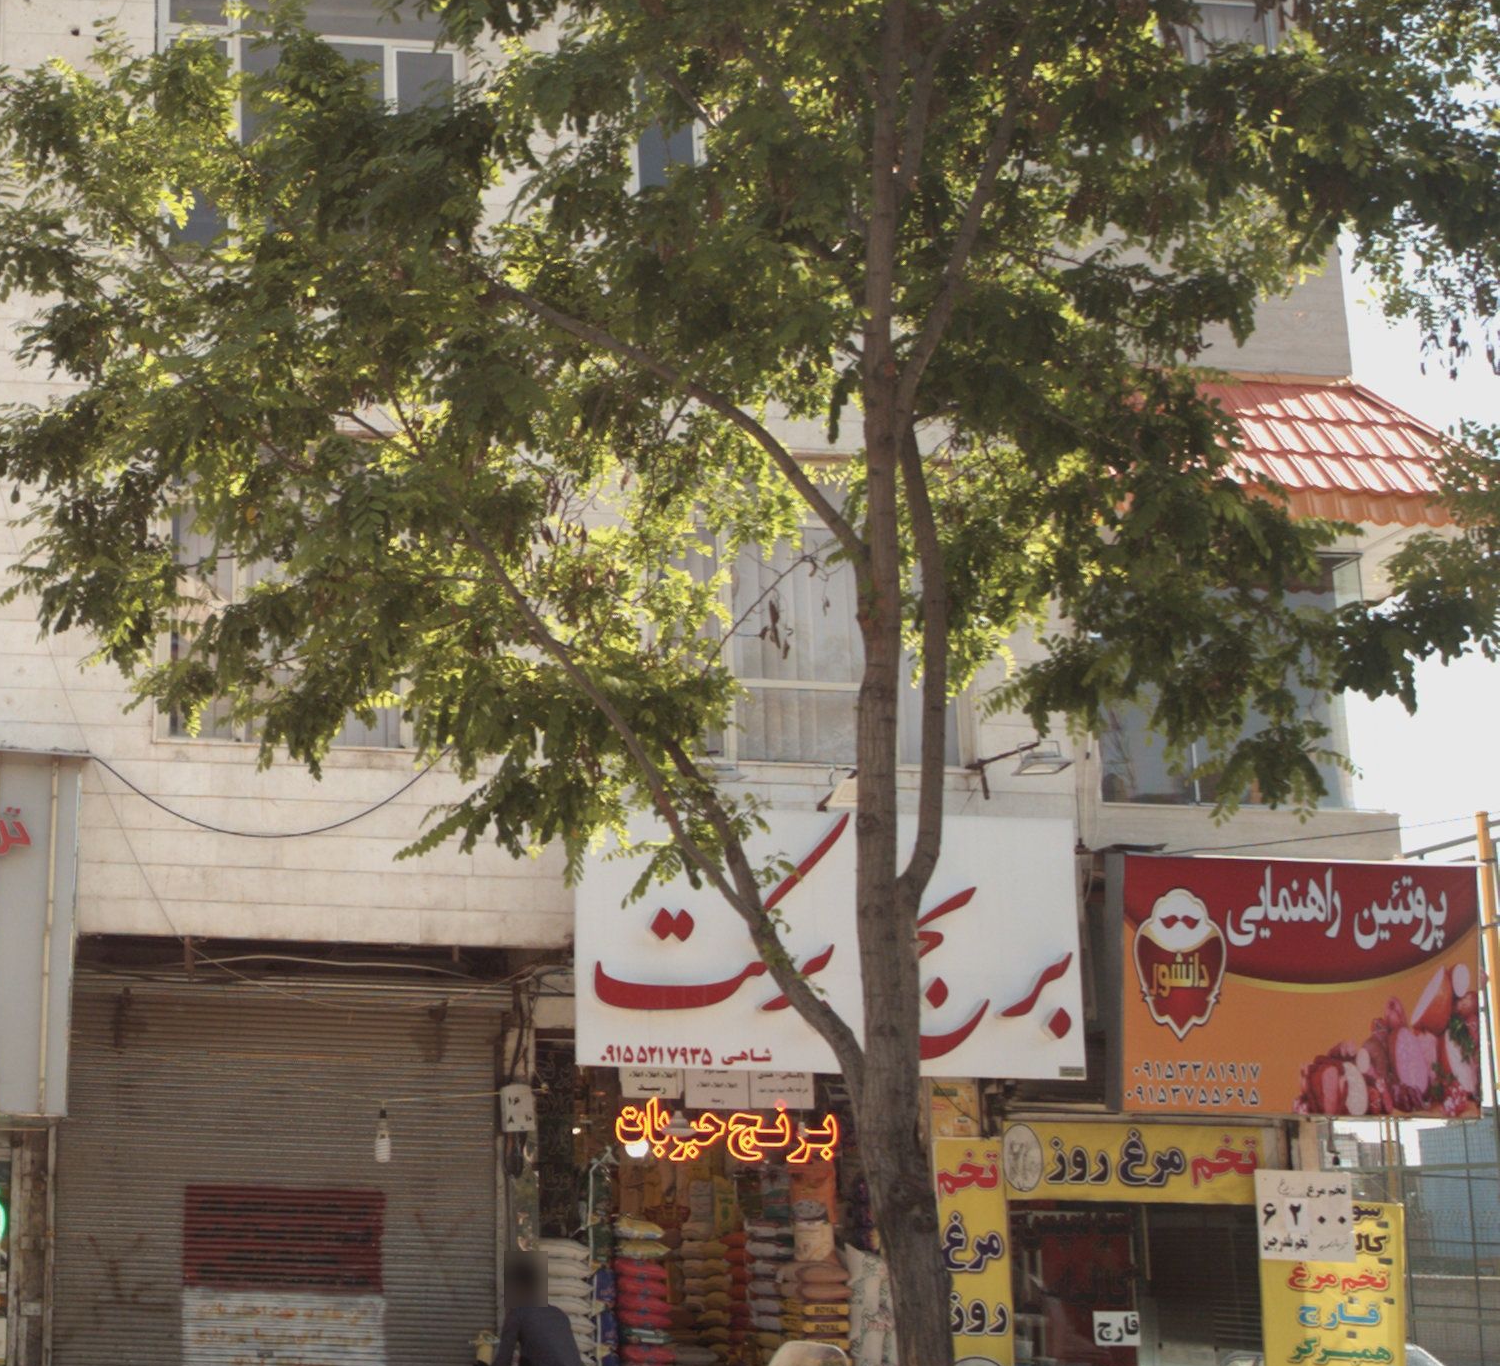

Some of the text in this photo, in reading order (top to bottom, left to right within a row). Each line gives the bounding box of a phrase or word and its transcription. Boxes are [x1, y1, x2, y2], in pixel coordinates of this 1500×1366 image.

[1226, 864, 1448, 952] پروتئین راهنمایی
[1149, 950, 1211, 999] دانشور
[600, 1044, 772, 1066] شاهی ۰۹۱۵۵۲۱۷۹۳۵
[1132, 1060, 1261, 1081] ۰۹۱۵۳۳۸۱۹۱۷
[1125, 1085, 1260, 1107] ۰۹۱۵۳۷۵۵۶۹۵
[727, 1098, 839, 1164] برنج
[937, 1149, 999, 1199] تخم
[1047, 1129, 1258, 1189] تخم مرغ روز
[941, 1211, 1004, 1272] مرغ
[1288, 1262, 1389, 1291] تخم مرغ
[950, 1292, 1009, 1335] روز
[1096, 1314, 1140, 1343] قارچ
[1299, 1302, 1381, 1328] قارچ
